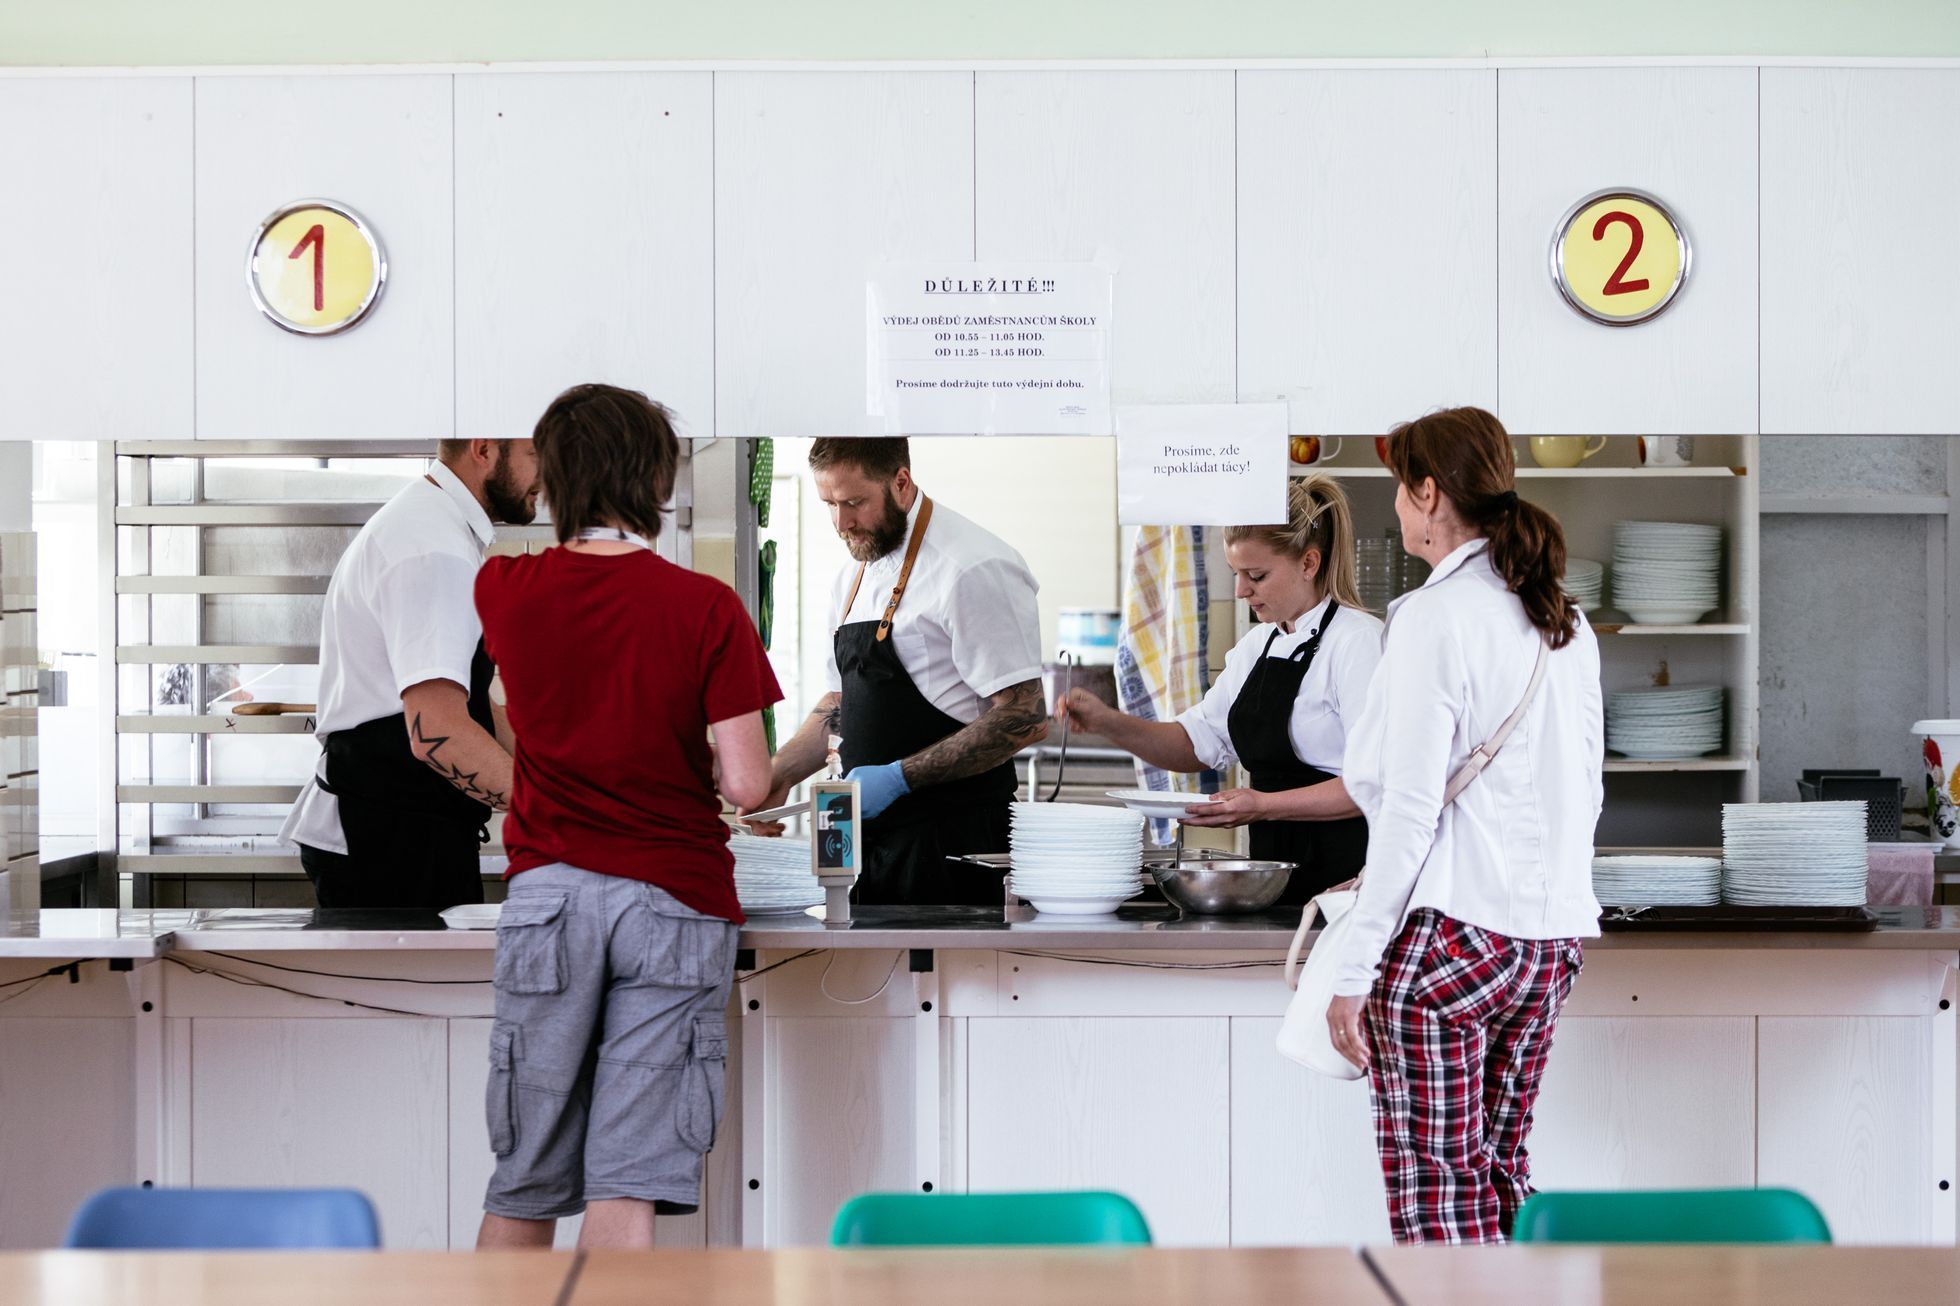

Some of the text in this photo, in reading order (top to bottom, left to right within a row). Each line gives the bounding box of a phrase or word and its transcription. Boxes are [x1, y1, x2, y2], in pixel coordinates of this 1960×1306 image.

[1592, 211, 1650, 296] 2
[288, 224, 324, 311] 1
[924, 277, 1055, 293] DŮLEŽITÉ!!!
[882, 315, 1097, 326] VÝDEJ OBĚDŮ ZAMĚSTNANCŮM ŠKOLY
[934, 332, 952, 342] OD
[954, 332, 979, 342] 10.55
[989, 332, 1015, 342] 11.05
[1017, 332, 1045, 342] HOD.
[934, 347, 952, 357] OD
[954, 348, 979, 357] 11.25
[989, 348, 1015, 357] 13.45
[1017, 347, 1045, 357] HOD.
[896, 379, 1085, 390] Prosíme dodržujte tuto výdejní dobu.
[1164, 444, 1240, 457] Prosíme, zde
[1153, 460, 1251, 477] nepokládat tácy!
